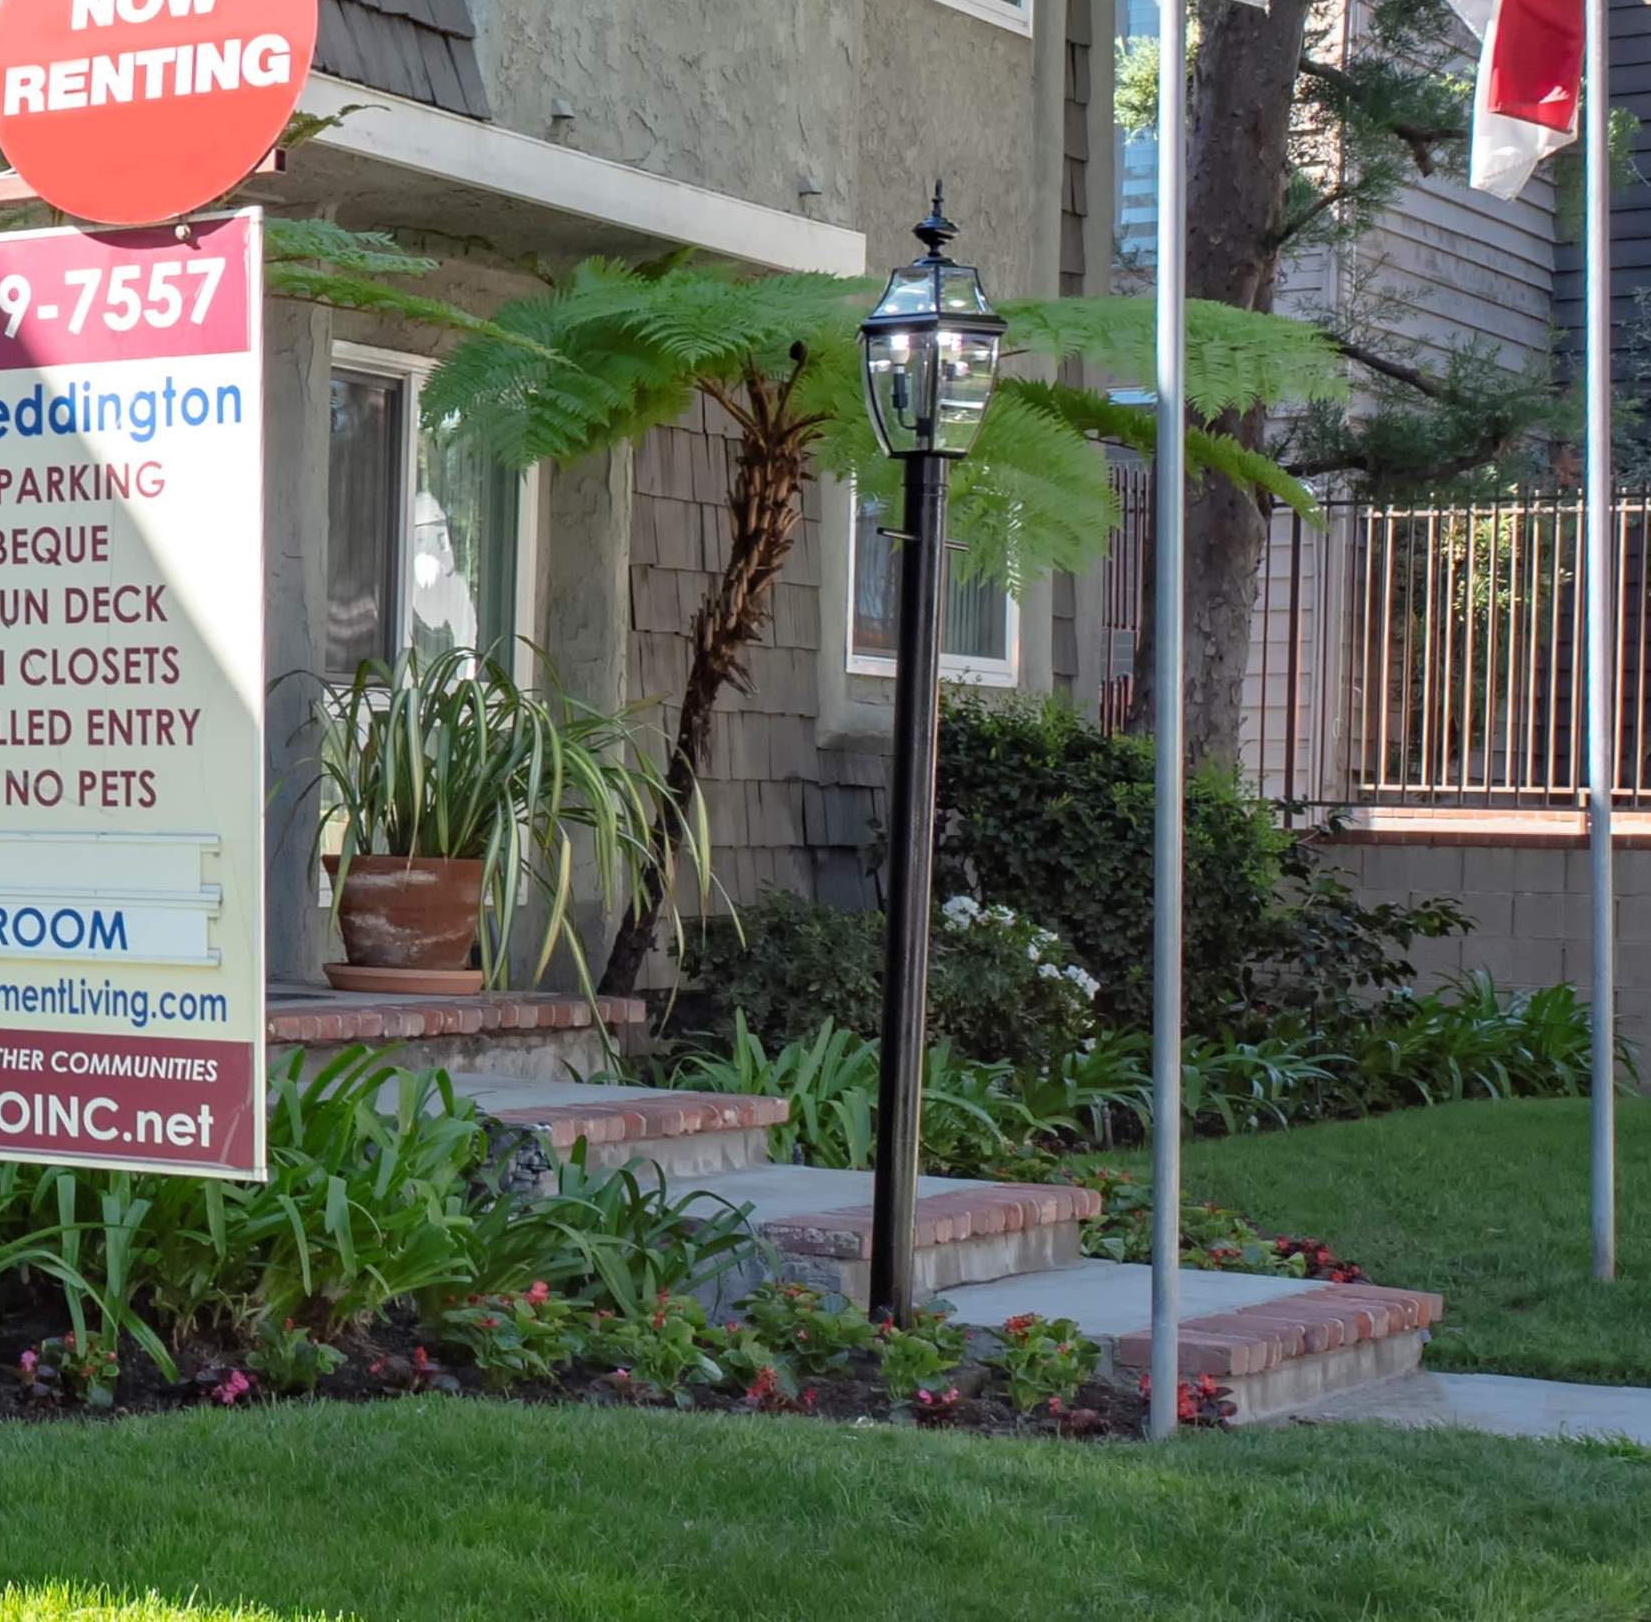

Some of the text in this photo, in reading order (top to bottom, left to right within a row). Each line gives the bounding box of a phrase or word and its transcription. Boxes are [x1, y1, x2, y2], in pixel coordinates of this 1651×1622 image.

[3, 34, 292, 117] RENTING
[65, 585, 167, 623] DECK
[19, 646, 180, 686] CLOSETS
[88, 709, 201, 747] ENTRY
[5, 769, 63, 807] NO
[78, 769, 156, 808] PETS
[50, 1051, 218, 1082] COMMUNITIES
